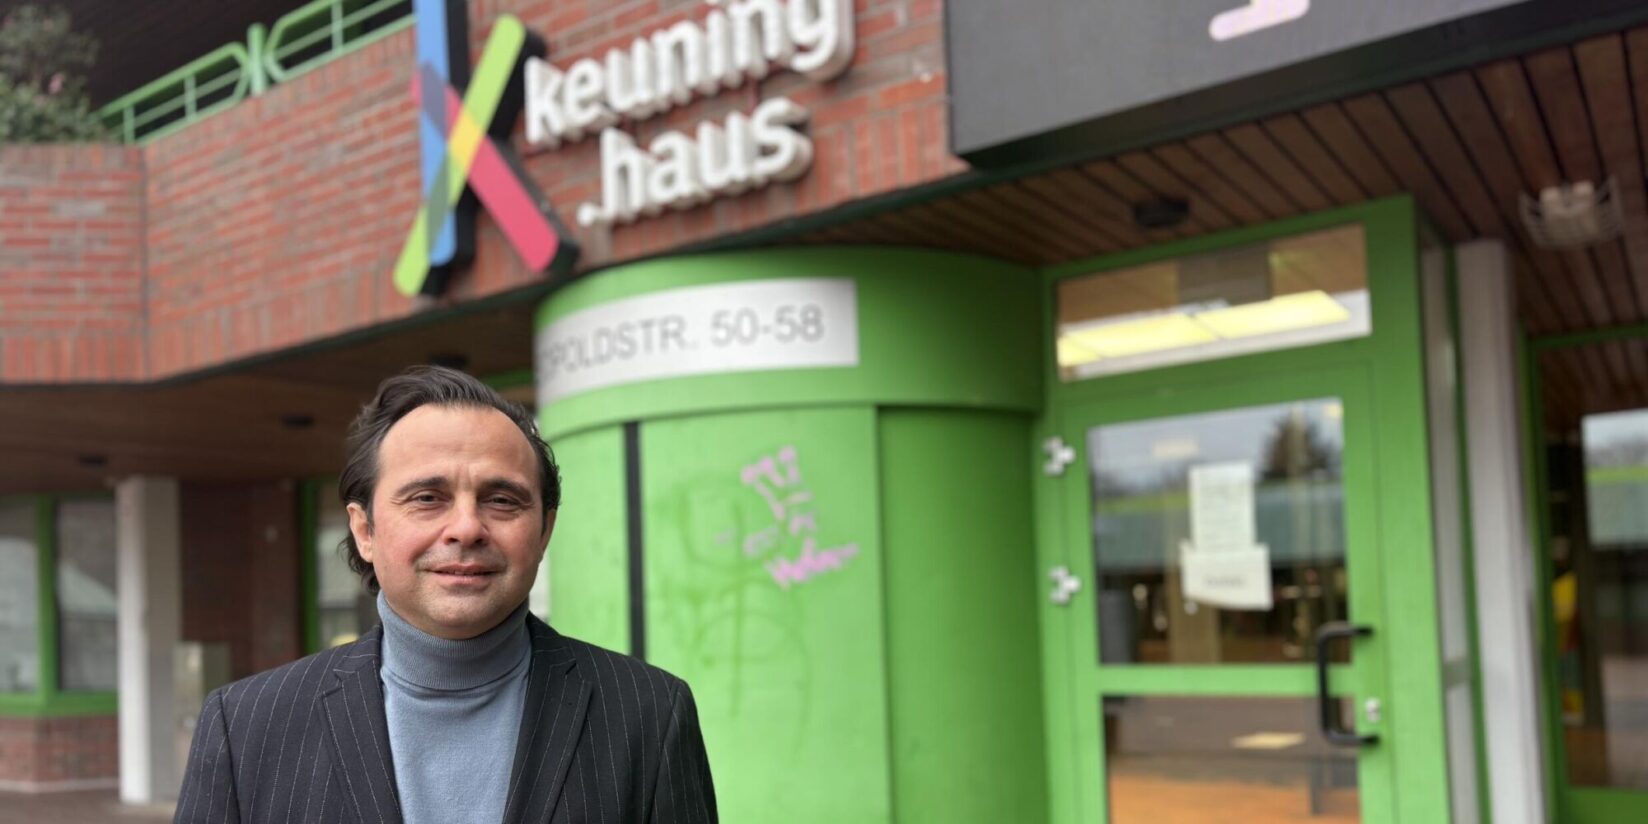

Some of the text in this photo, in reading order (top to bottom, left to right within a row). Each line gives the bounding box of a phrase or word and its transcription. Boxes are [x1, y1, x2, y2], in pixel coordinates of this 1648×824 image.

[524, 0, 843, 146] keuning
[577, 97, 802, 227] .haus
[710, 303, 825, 347] 50-58
